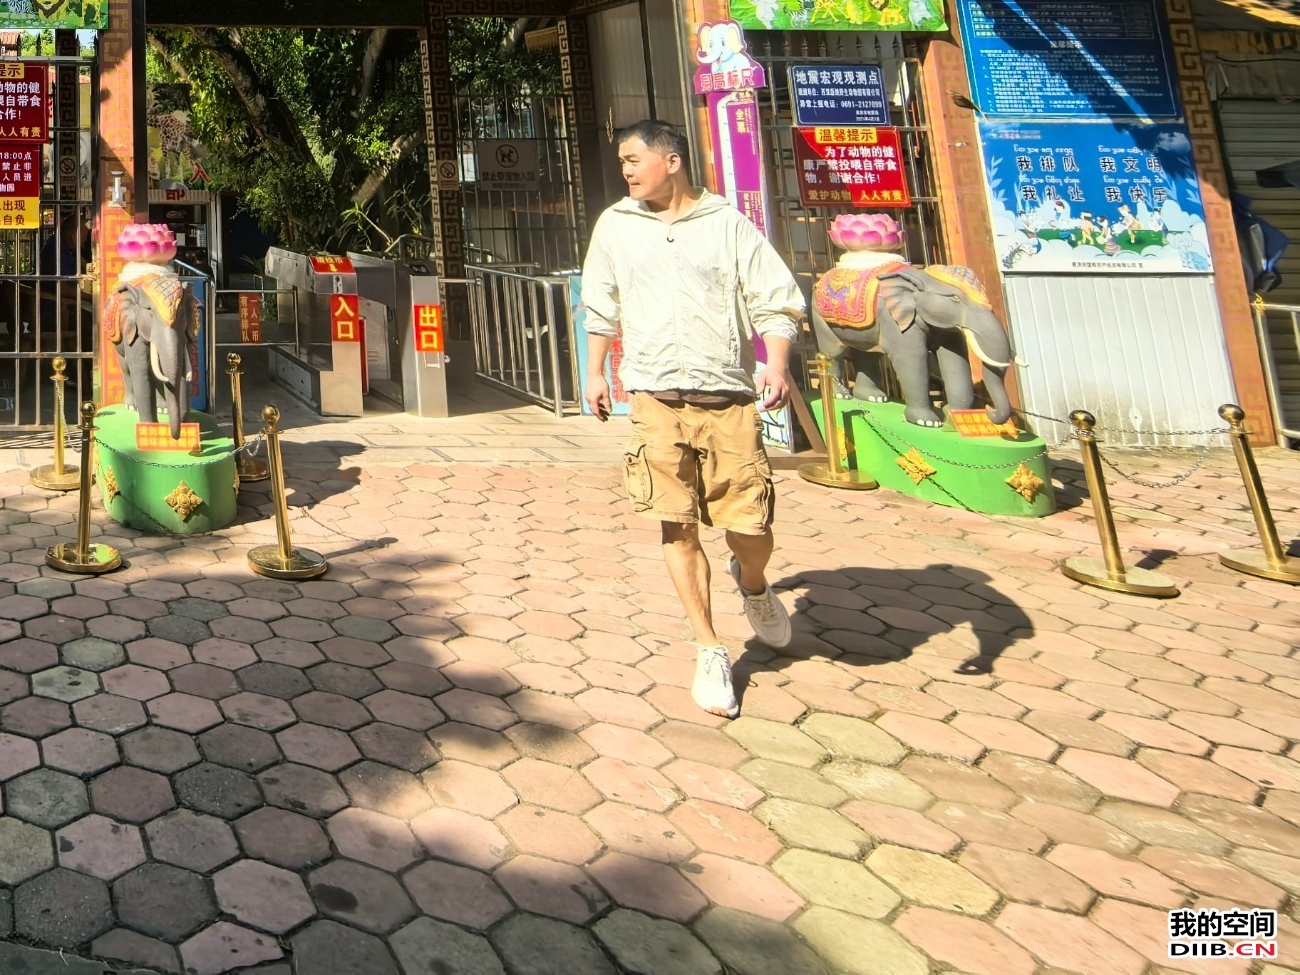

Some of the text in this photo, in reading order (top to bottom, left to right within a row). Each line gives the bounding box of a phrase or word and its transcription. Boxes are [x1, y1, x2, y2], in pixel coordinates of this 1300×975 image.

[700, 68, 755, 91] 身高标尺
[795, 70, 880, 86] 地震宏观观测点
[819, 128, 874, 142] 温馨提示
[825, 146, 895, 158] 为了动物的健
[803, 159, 897, 171] 康严禁投喂自带食
[1015, 156, 1079, 173] 我排队
[1100, 157, 1163, 173] 我文明
[808, 190, 903, 201] 爱护动物 人人有责
[1021, 186, 1086, 202] 我礼让
[1105, 187, 1168, 203] 我快乐
[240, 295, 250, 342] 有序排队
[250, 298, 260, 341] 一人一币
[334, 296, 355, 339] 入口
[419, 305, 438, 349] 出口
